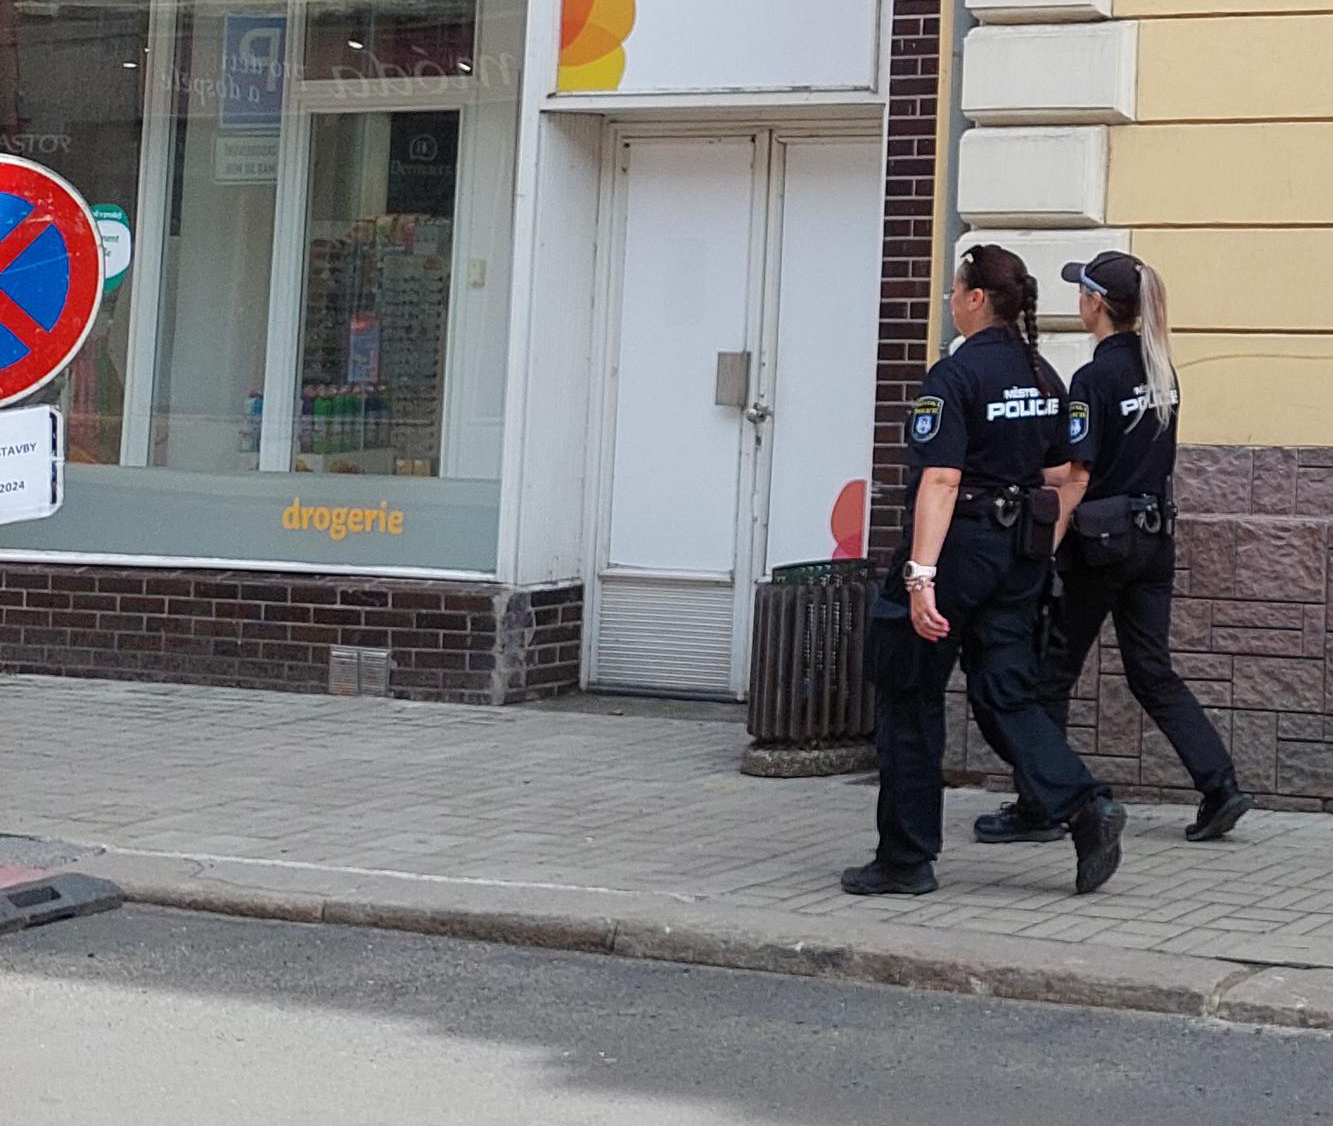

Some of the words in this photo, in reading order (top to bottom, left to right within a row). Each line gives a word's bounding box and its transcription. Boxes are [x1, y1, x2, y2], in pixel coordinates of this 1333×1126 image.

[986, 398, 1060, 421] POLICIE
[0, 441, 38, 457] TAVBY
[282, 497, 405, 541] drogerie
